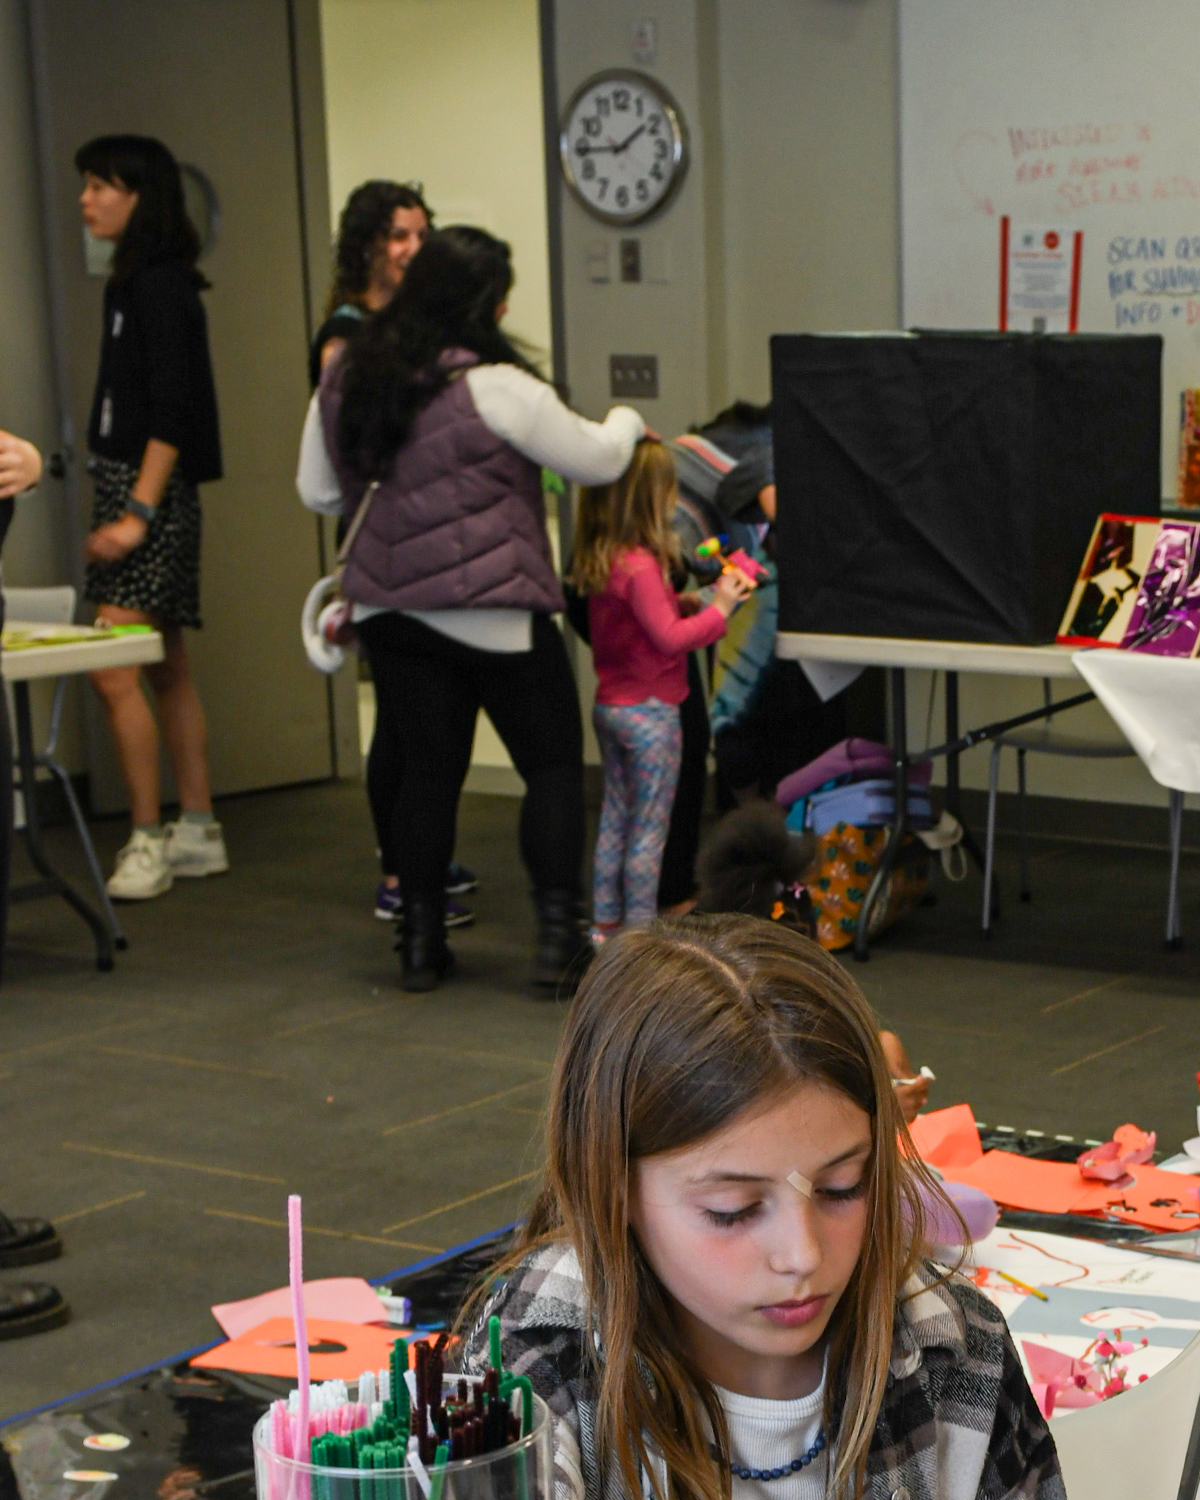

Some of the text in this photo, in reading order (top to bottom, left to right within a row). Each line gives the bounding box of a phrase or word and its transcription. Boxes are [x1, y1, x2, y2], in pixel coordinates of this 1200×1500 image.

[596, 96, 610, 117] 11
[612, 90, 630, 111] 12
[635, 97, 644, 117] 1
[580, 116, 602, 137] 10
[647, 114, 661, 135] 2
[653, 139, 667, 159] 3
[581, 159, 596, 180] 8
[650, 162, 663, 182] 4
[596, 178, 609, 199] 7
[615, 186, 628, 208] 6
[635, 180, 649, 201] 5
[1108, 236, 1165, 262] SCAN
[1116, 302, 1161, 327] INFO
